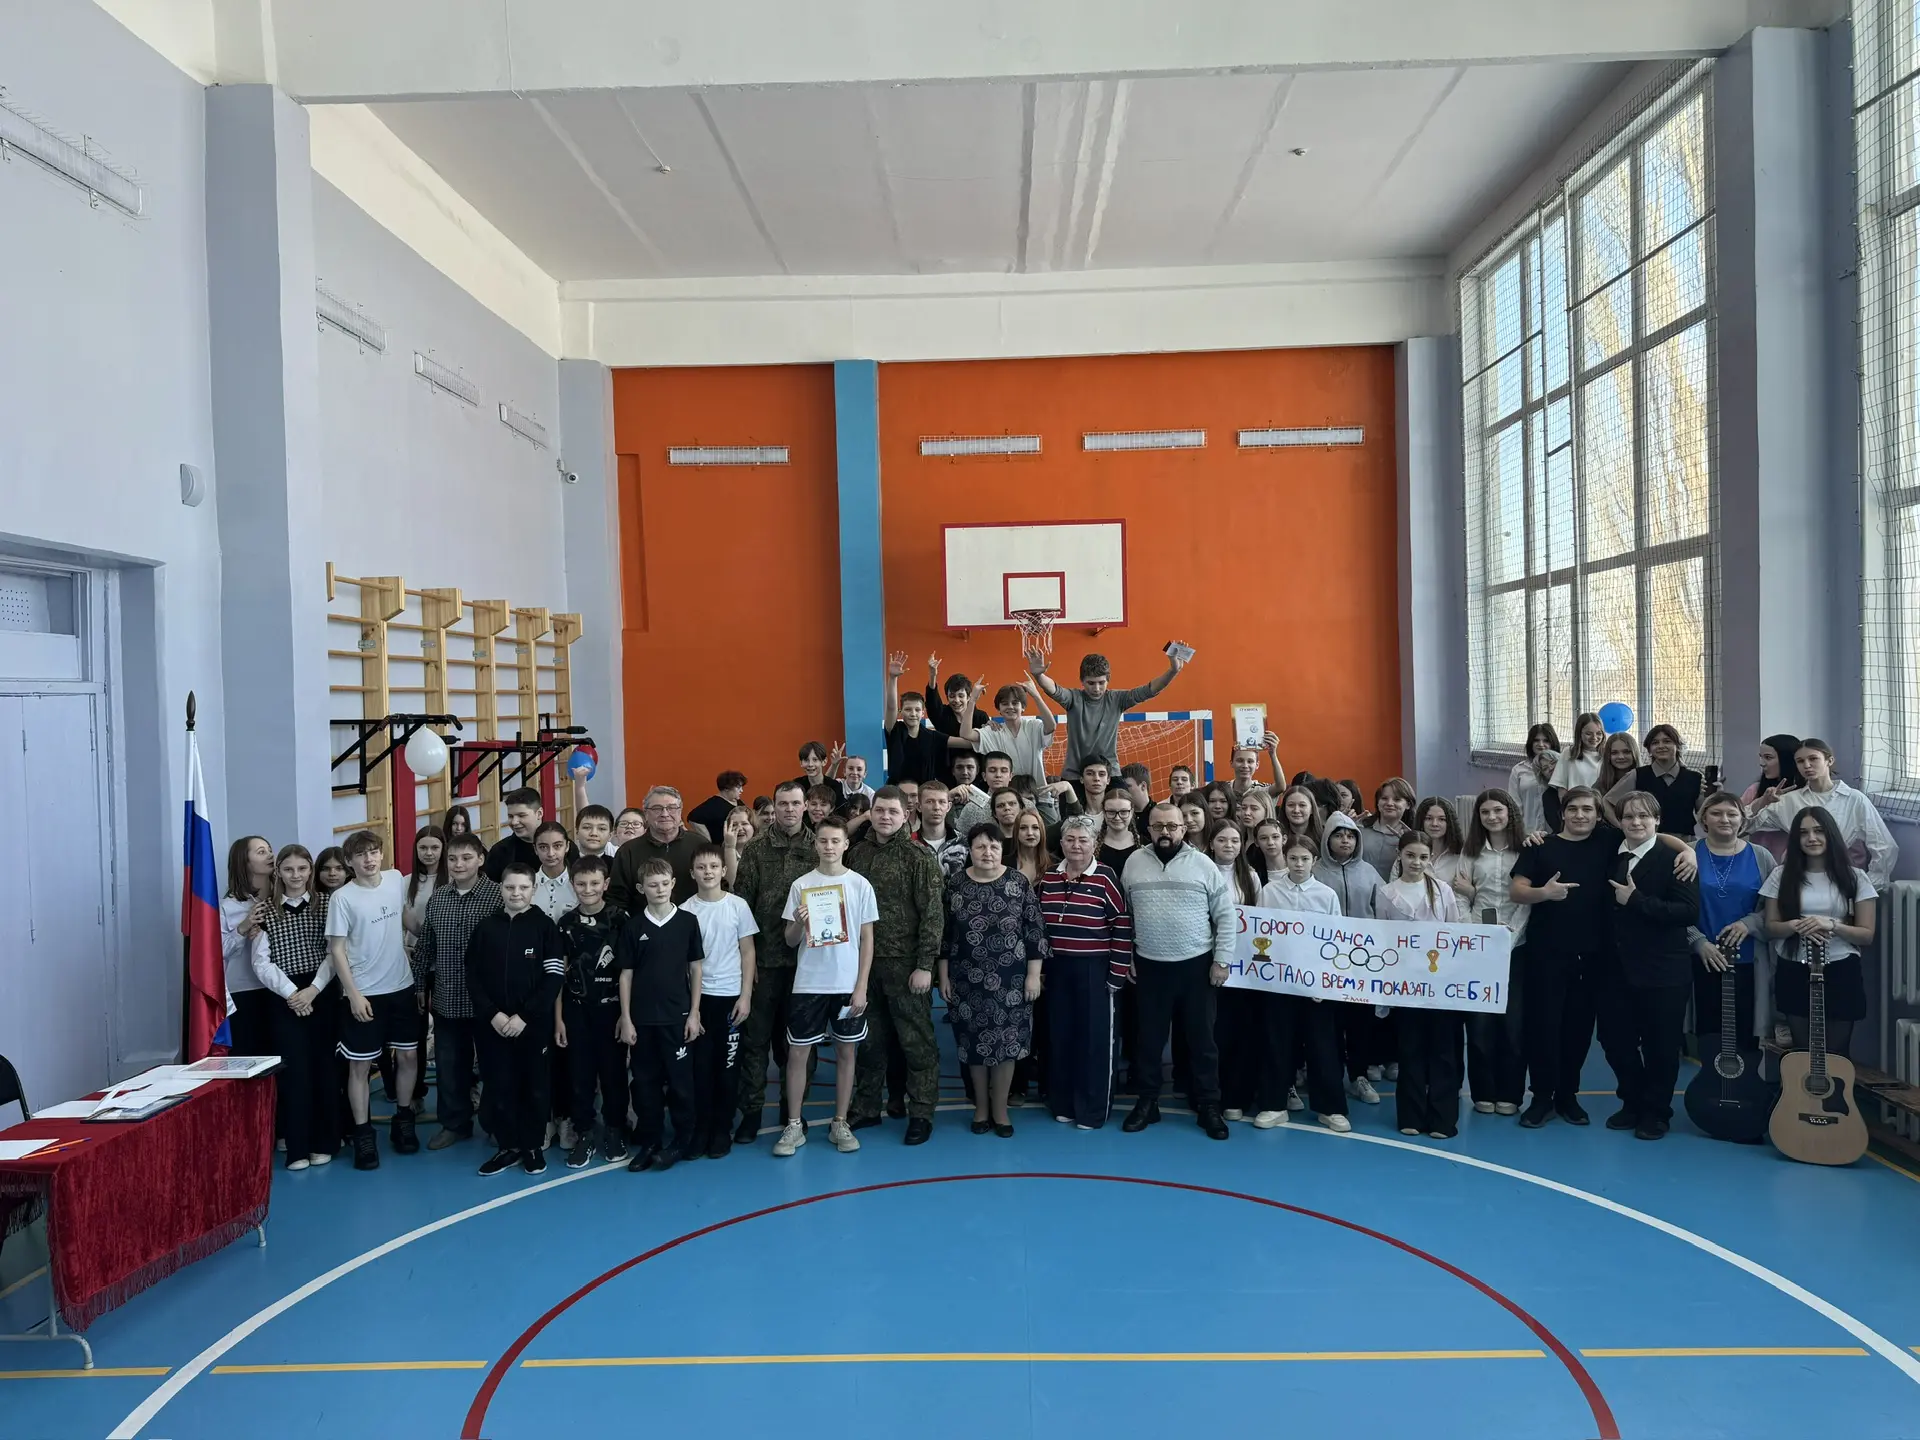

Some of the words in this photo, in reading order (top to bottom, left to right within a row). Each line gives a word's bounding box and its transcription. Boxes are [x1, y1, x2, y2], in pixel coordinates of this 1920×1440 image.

[1312, 925, 1375, 947] ШАНСА
[1397, 934, 1421, 949] НЕ
[1229, 959, 1315, 987] НАСТАЛО
[1321, 971, 1365, 992] ВРЕМЯ
[1370, 979, 1436, 998] ПОКАЗАТЬ
[1444, 980, 1500, 1004] СЕБЯ!
